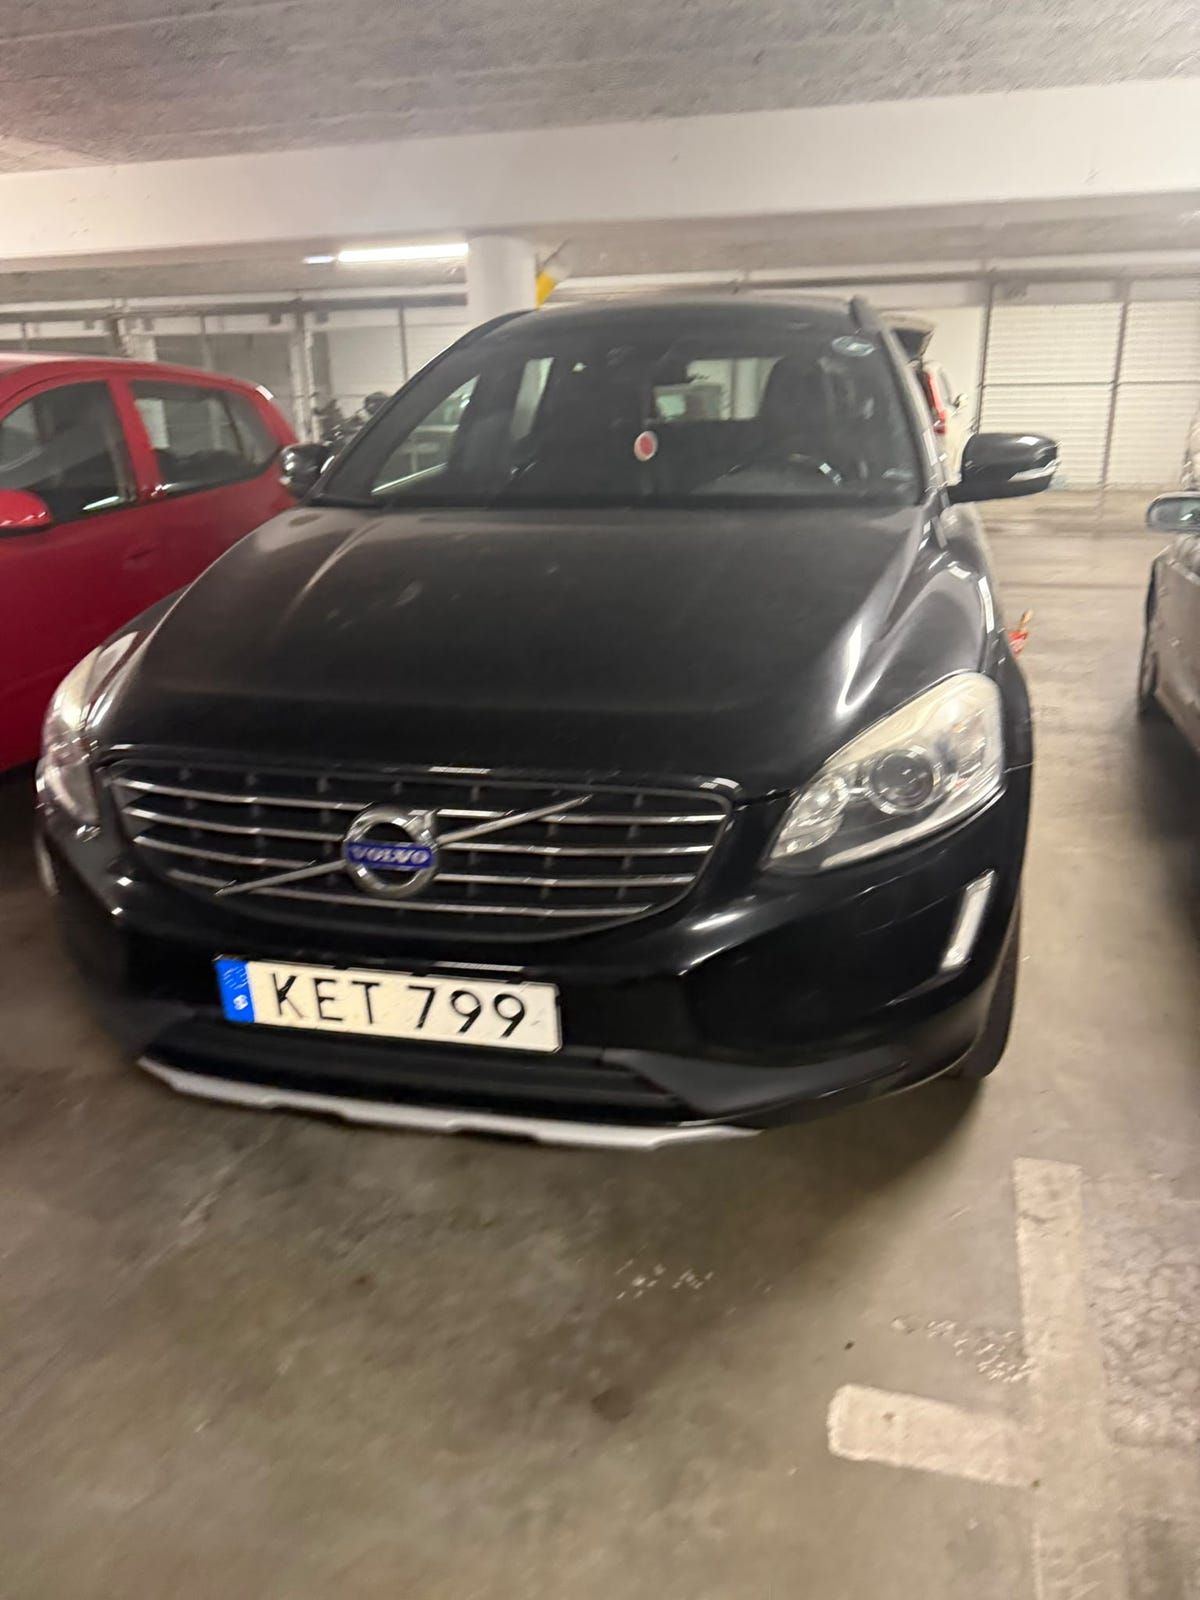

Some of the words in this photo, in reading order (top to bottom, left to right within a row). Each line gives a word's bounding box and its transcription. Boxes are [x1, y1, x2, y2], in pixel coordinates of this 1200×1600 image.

[349, 847, 431, 865] VOLVO
[272, 973, 380, 1025] KET
[408, 985, 526, 1039] 799
